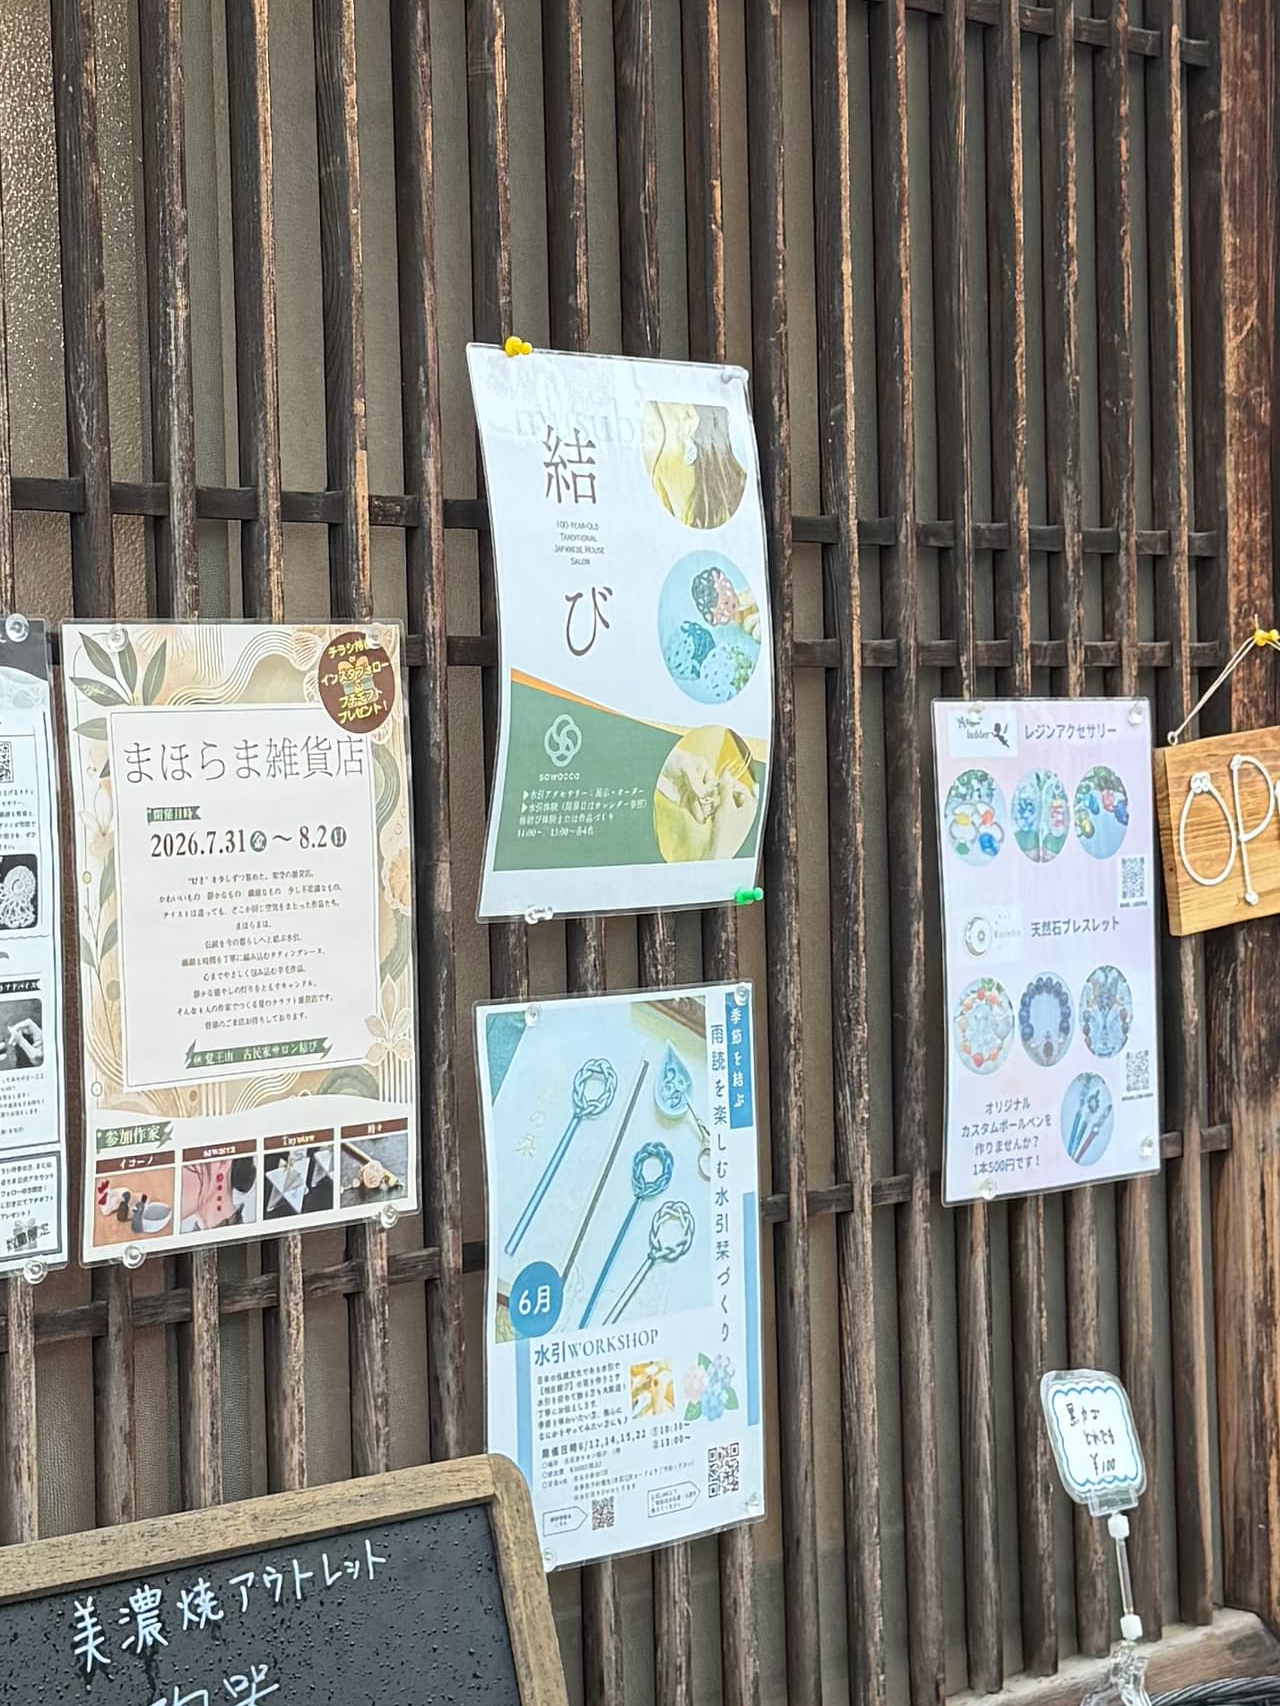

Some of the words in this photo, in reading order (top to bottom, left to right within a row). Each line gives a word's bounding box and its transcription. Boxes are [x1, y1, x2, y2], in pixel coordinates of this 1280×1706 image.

[1025, 724, 1117, 740] レジンアクセサリー
[123, 735, 364, 784] まほらま雑貨店
[1031, 916, 1120, 938] 天然石ブレスレット
[730, 1008, 745, 1108] 季節を結ぶ
[985, 1098, 1031, 1115] オリジナル
[105, 1124, 160, 1146] 参加作家
[961, 1114, 1052, 1138] カスタムボールペンを
[518, 1285, 551, 1315] 6月
